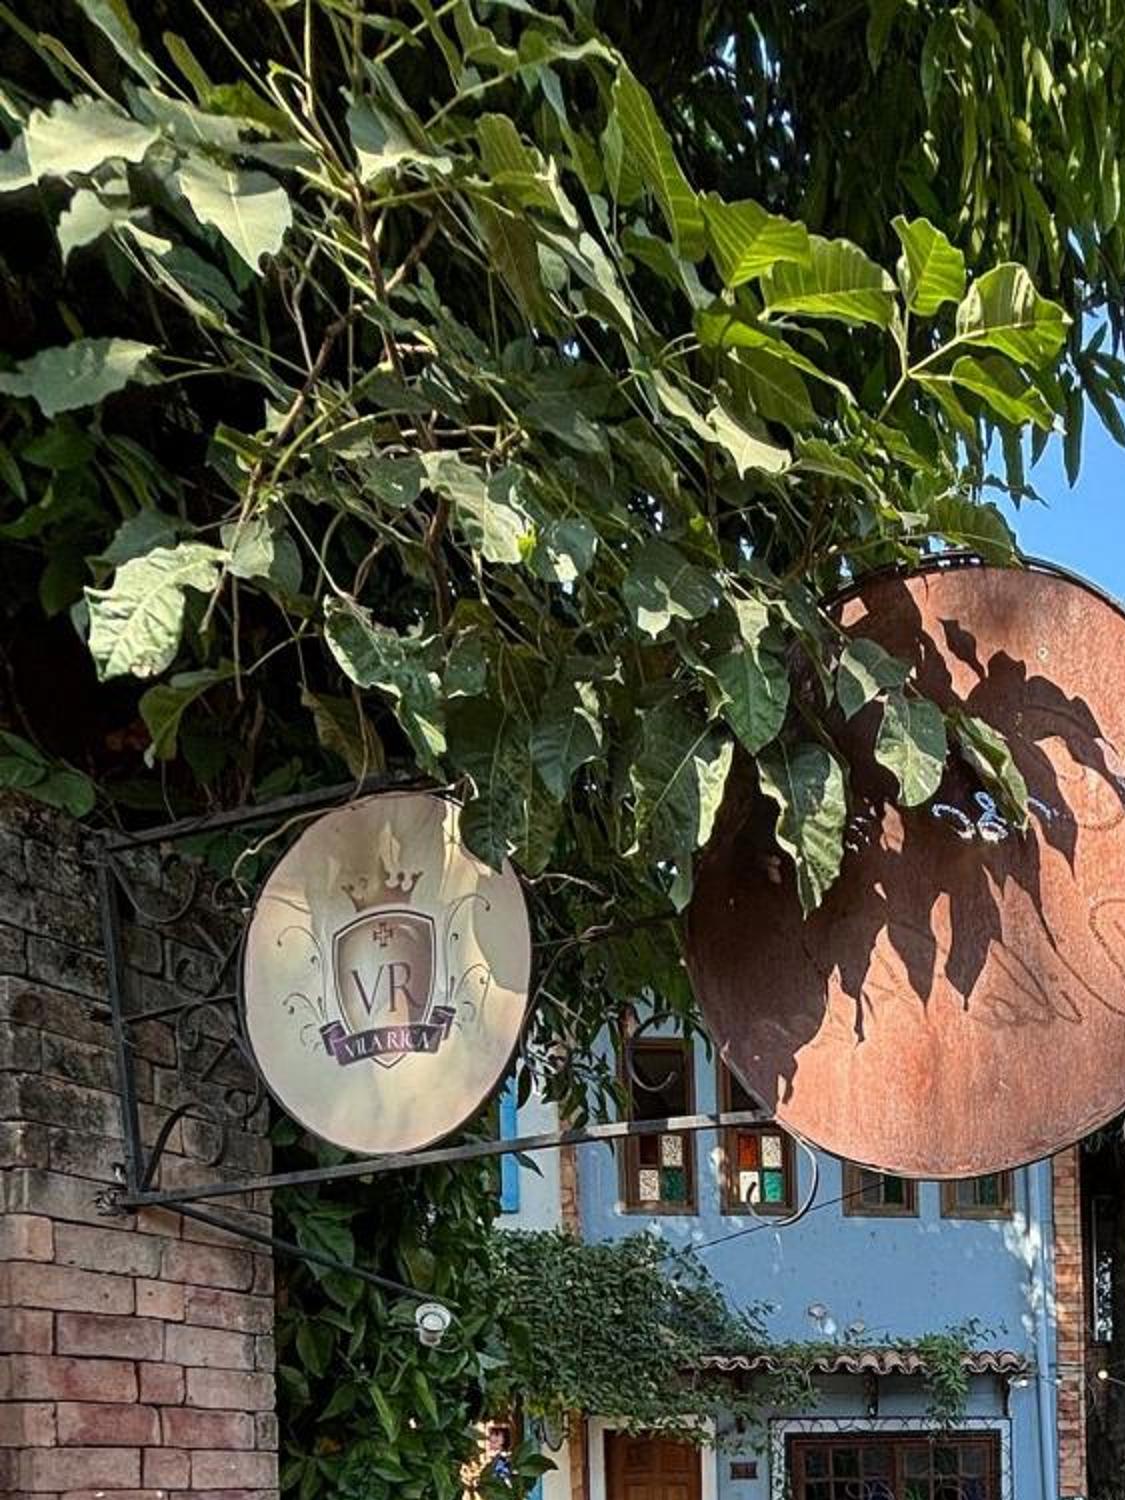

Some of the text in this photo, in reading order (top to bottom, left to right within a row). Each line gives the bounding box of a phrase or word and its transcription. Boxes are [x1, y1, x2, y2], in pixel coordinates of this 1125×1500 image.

[351, 961, 425, 1016] VR
[344, 1031, 430, 1058] VILA RICA
